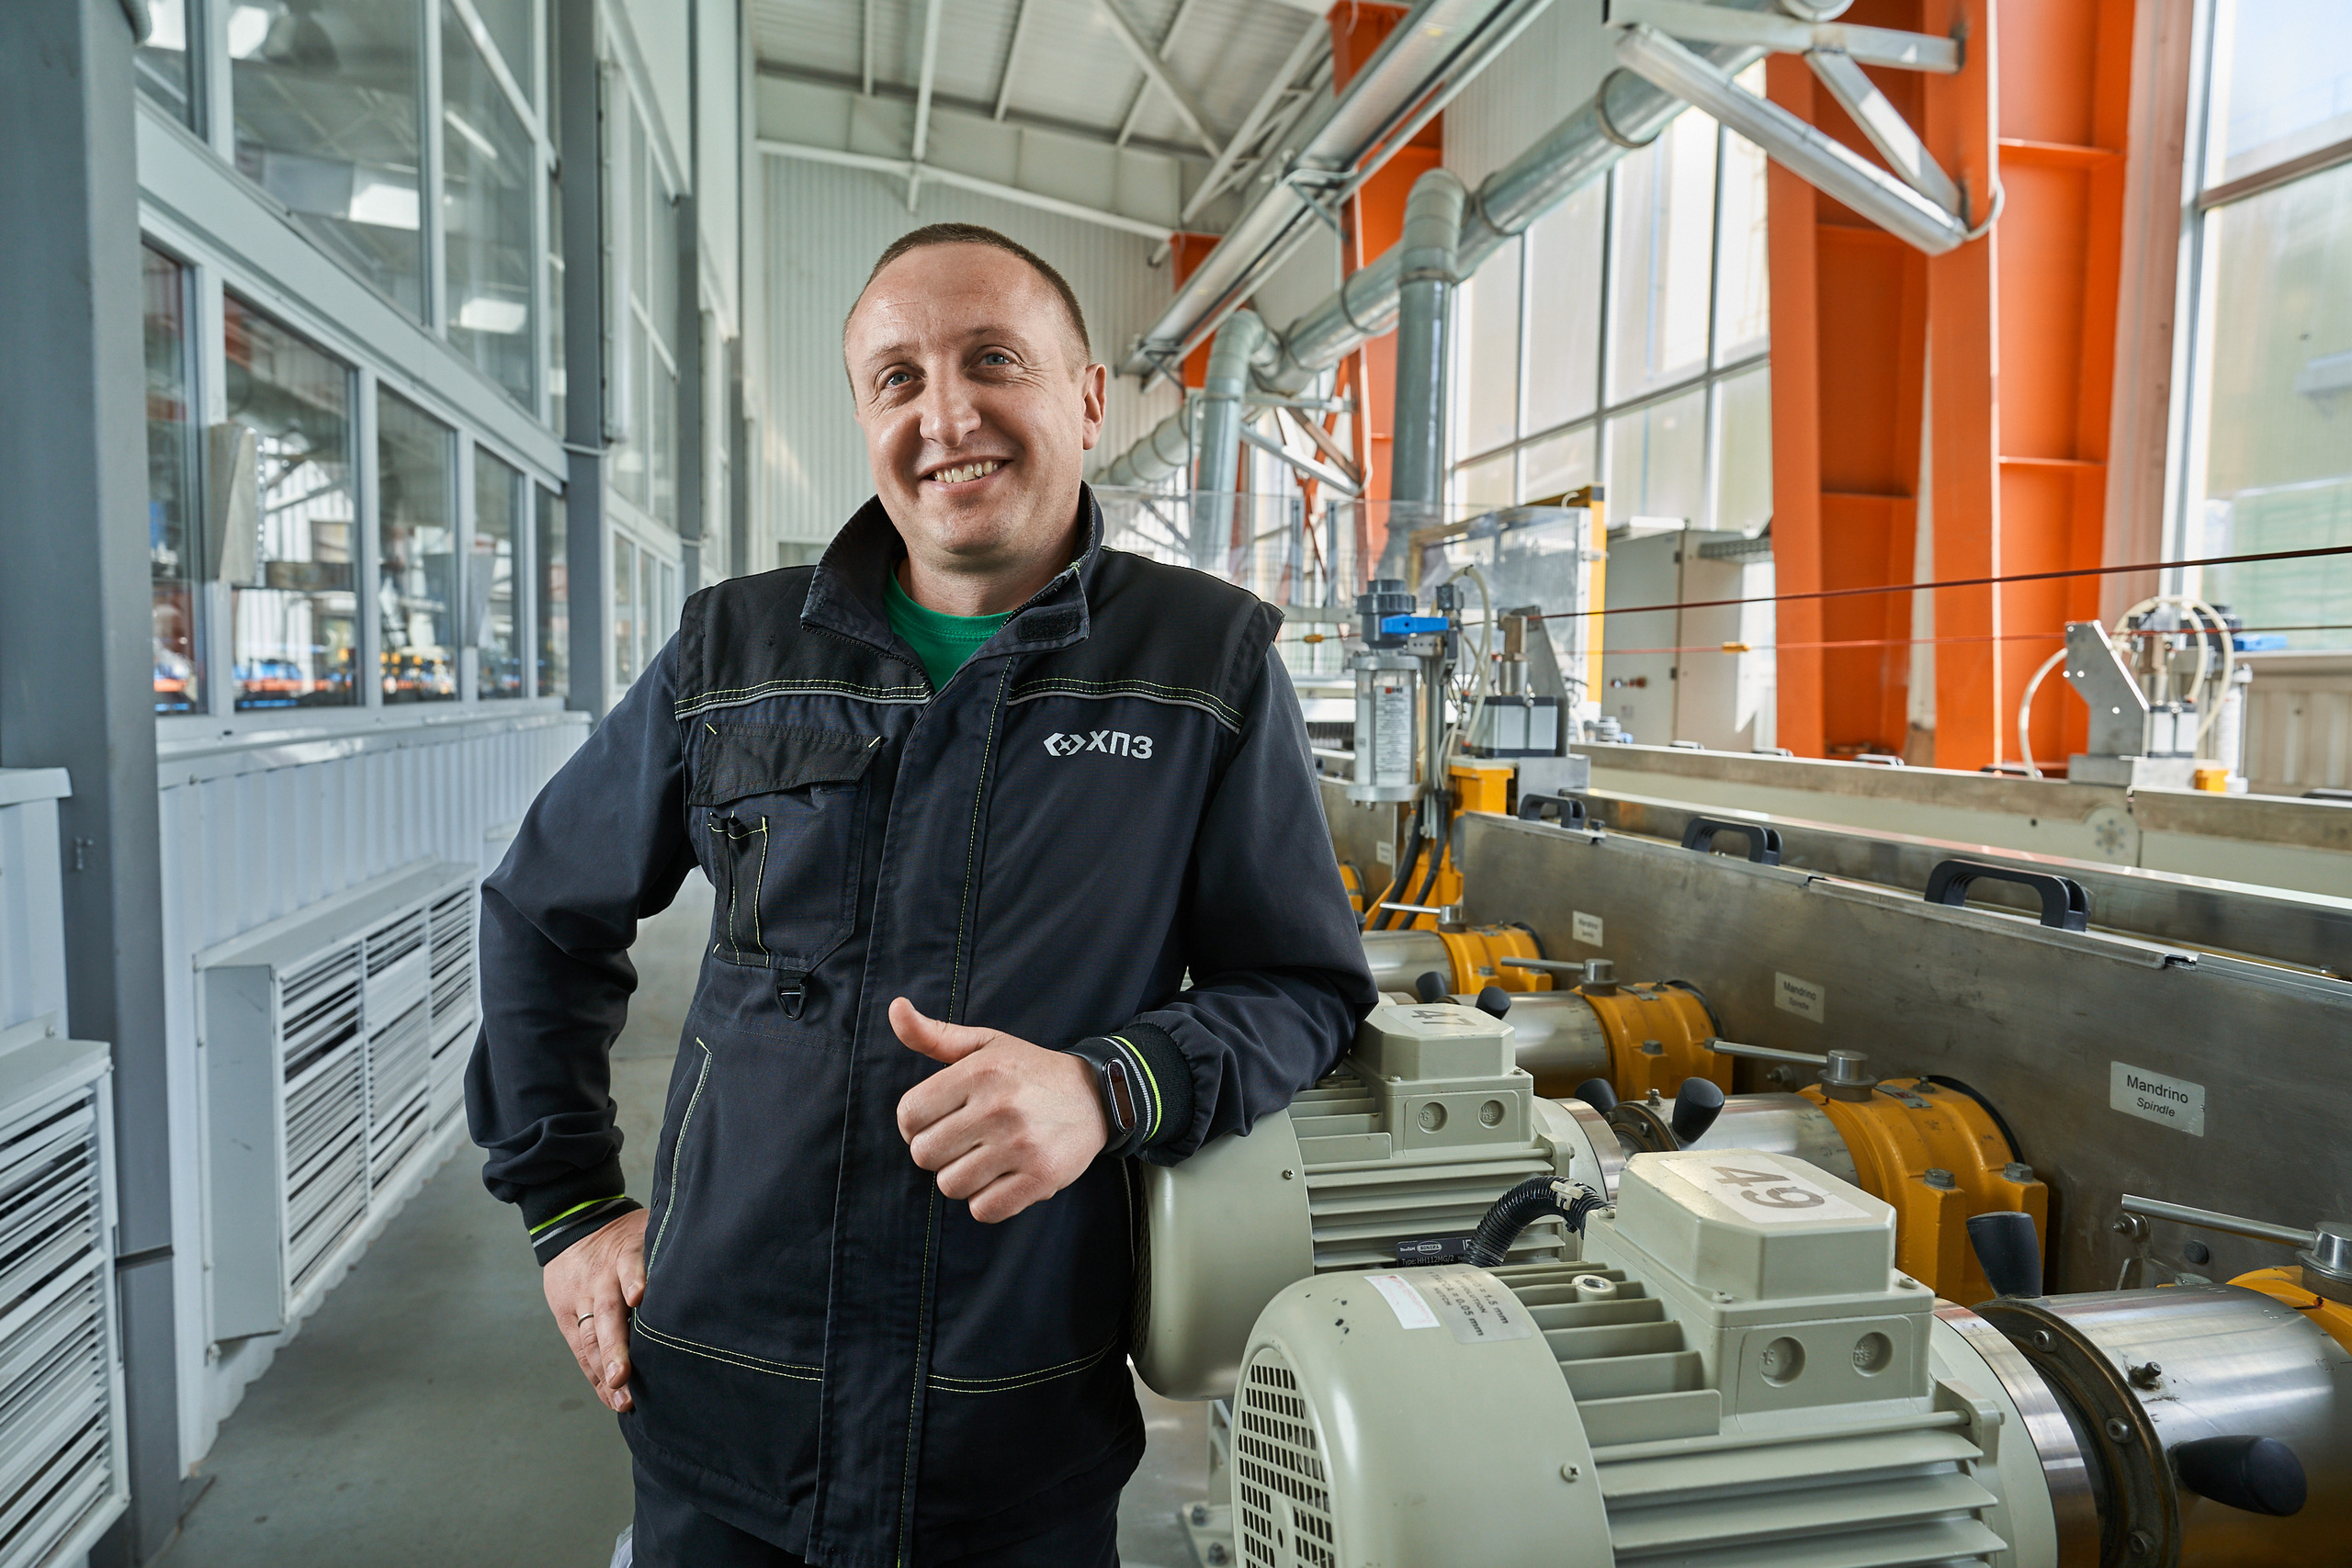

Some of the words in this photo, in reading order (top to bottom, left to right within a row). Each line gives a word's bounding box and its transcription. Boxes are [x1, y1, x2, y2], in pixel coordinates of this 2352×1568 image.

[1085, 729, 1153, 760] ХПЗ
[2127, 1075, 2188, 1104] Mandrino
[2136, 1097, 2176, 1117] Spindle
[1710, 1166, 1826, 1209] 49
[1402, 1258, 1416, 1266] Type:
[1455, 1298, 1474, 1316] 0.05
[1469, 1317, 1484, 1337] mm
[1484, 1293, 1498, 1305] 1.5
[1493, 1306, 1509, 1324] mm
